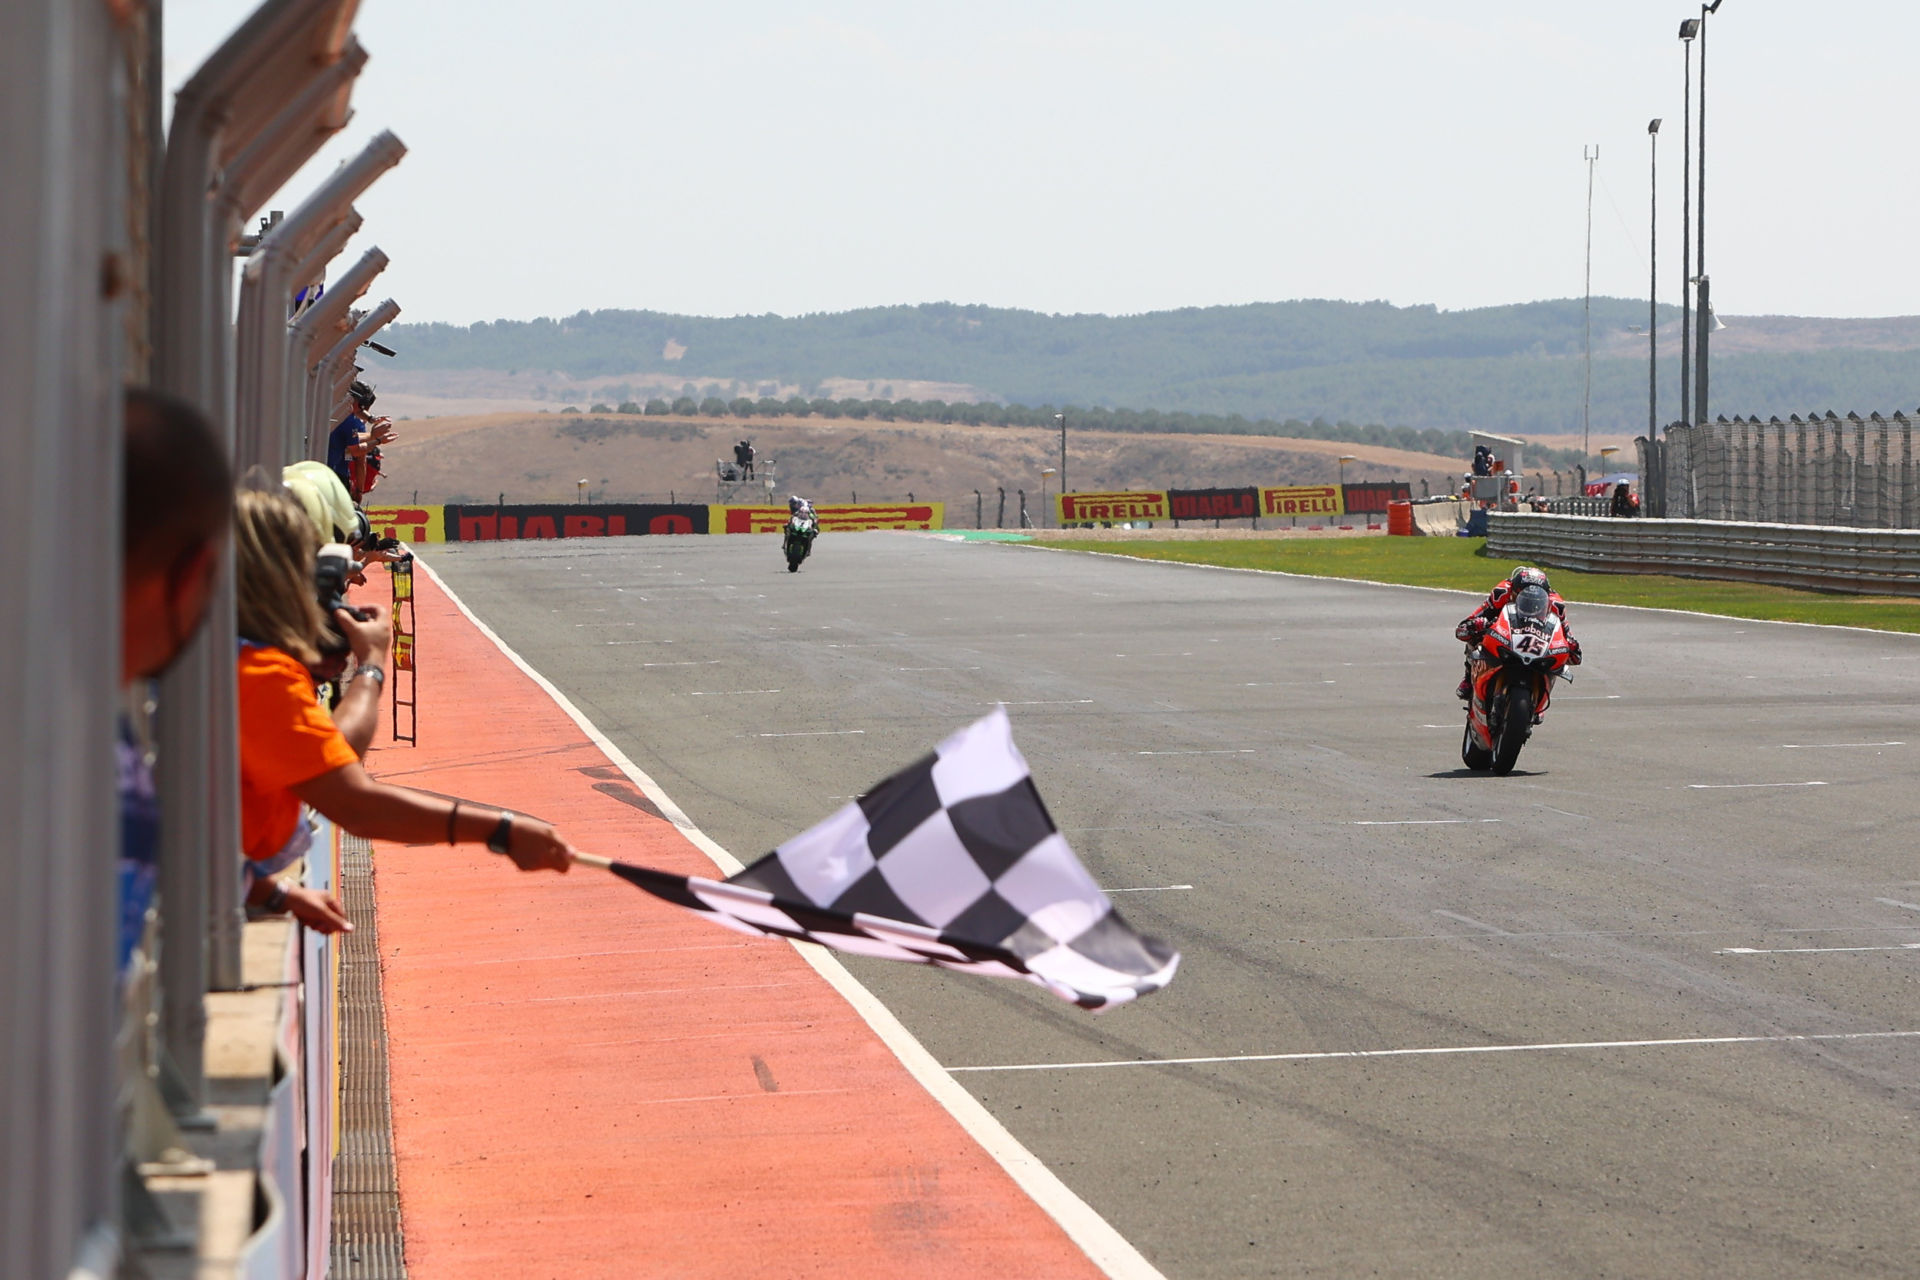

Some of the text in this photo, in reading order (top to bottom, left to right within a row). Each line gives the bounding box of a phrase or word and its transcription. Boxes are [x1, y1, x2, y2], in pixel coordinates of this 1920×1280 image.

[1062, 494, 1163, 519] PIRELLI
[1173, 495, 1254, 517] DIABLO
[1265, 488, 1337, 514] PIRELLI
[1516, 635, 1546, 656] 45
